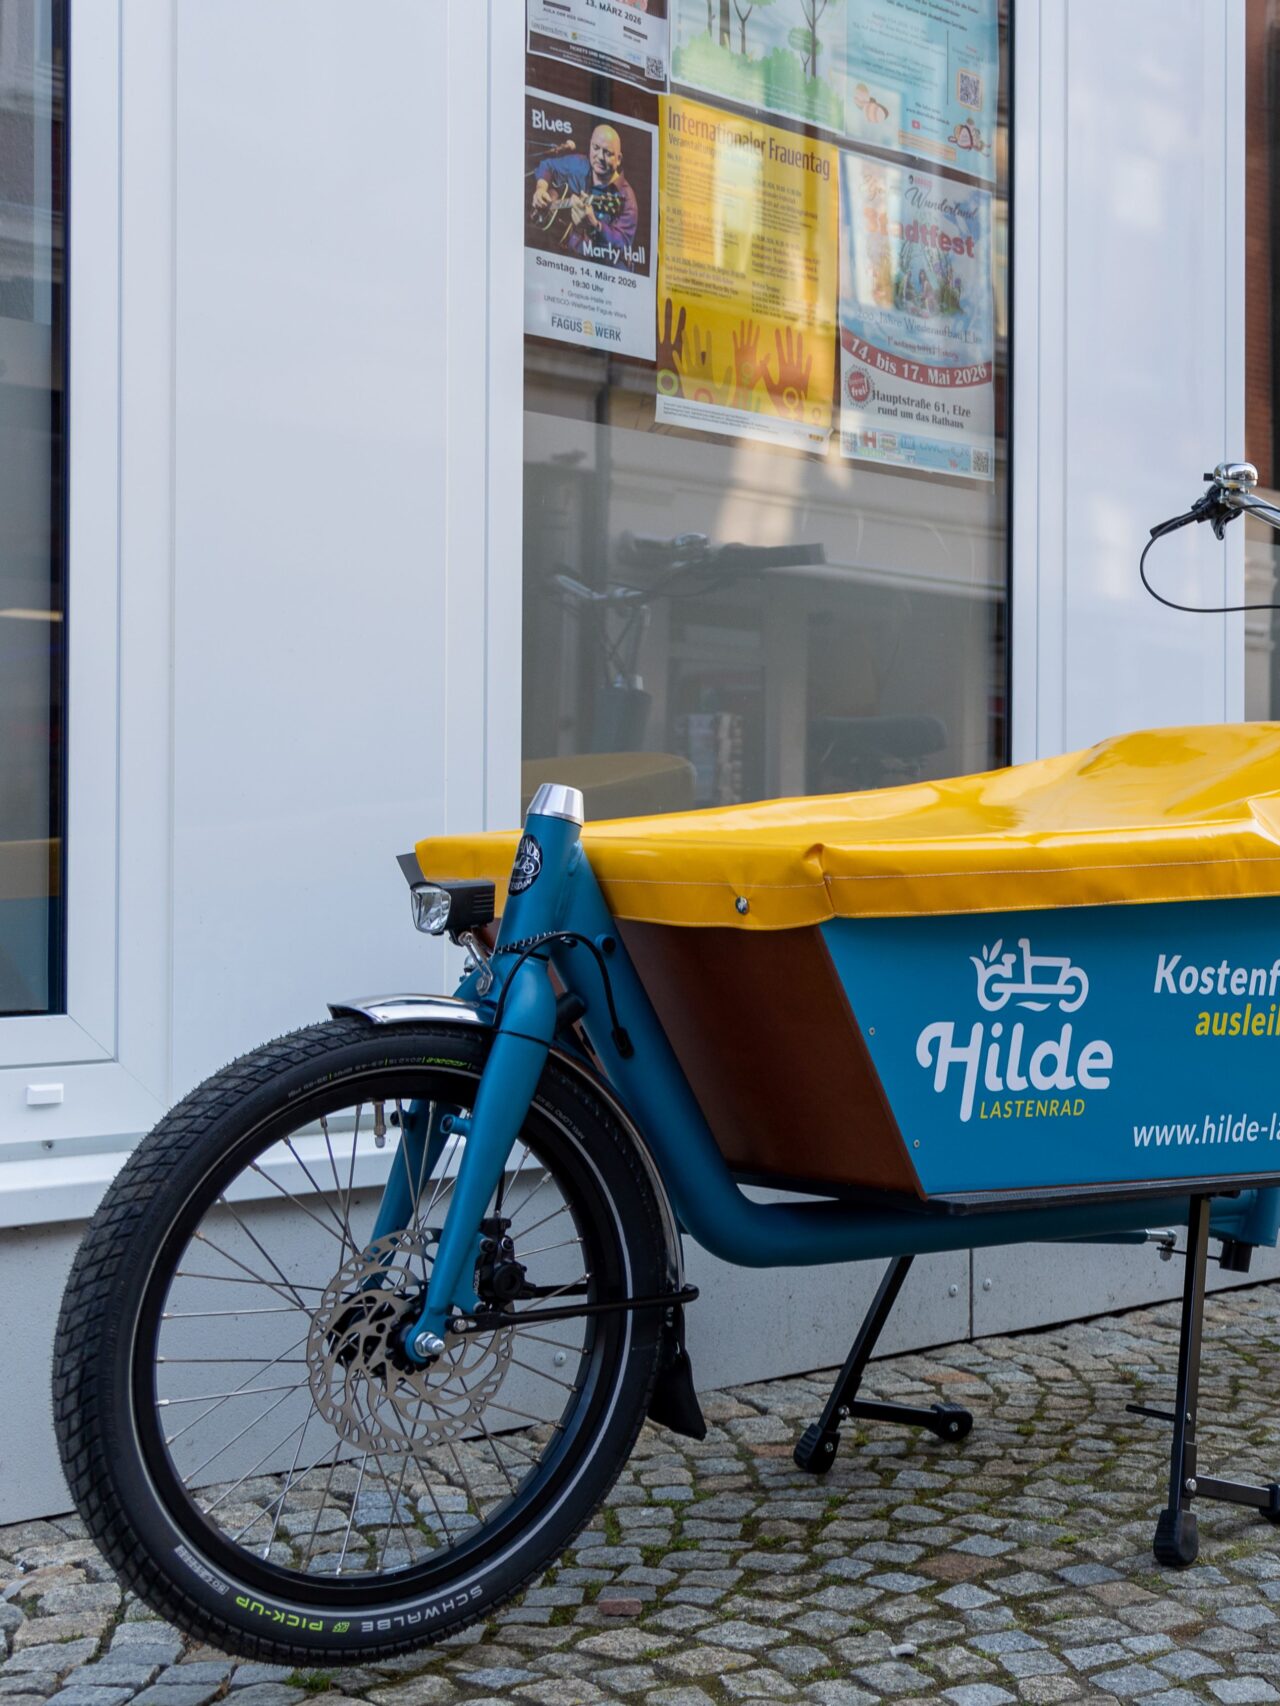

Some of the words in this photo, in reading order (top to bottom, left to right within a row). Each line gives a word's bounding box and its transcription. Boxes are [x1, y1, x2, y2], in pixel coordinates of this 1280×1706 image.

[600, 2, 623, 17] MÄRZ
[624, 11, 642, 25] 2026
[531, 108, 573, 134] Blues
[668, 106, 766, 156] Internationaler
[768, 137, 830, 181] Frauentag
[904, 186, 979, 219] Wunderland
[863, 207, 975, 259] Stadtfest
[582, 239, 620, 264] Marty
[624, 244, 646, 264] Hall
[536, 256, 578, 275] Samstag,
[580, 266, 593, 278] 14.
[595, 270, 616, 283] März
[618, 276, 637, 289] 2026
[591, 283, 604, 293] Uhr
[551, 316, 583, 333] FAGUS
[595, 324, 621, 341] WERK
[851, 338, 871, 363] 14.
[876, 352, 897, 375] bis
[902, 363, 924, 382] 17.
[927, 368, 950, 385] Mai
[955, 364, 987, 384] 2026
[872, 389, 931, 411] Hauptstraße
[953, 405, 971, 418] Elze
[877, 405, 898, 418] rund
[900, 410, 914, 420] um
[915, 410, 930, 422] das
[931, 414, 965, 429] Rathaus
[916, 1021, 1114, 1123] Hilde
[980, 1098, 1086, 1120] LASTENRAD
[235, 1595, 324, 1632] PICK-UP
[360, 1584, 484, 1634] SCHWALBE
